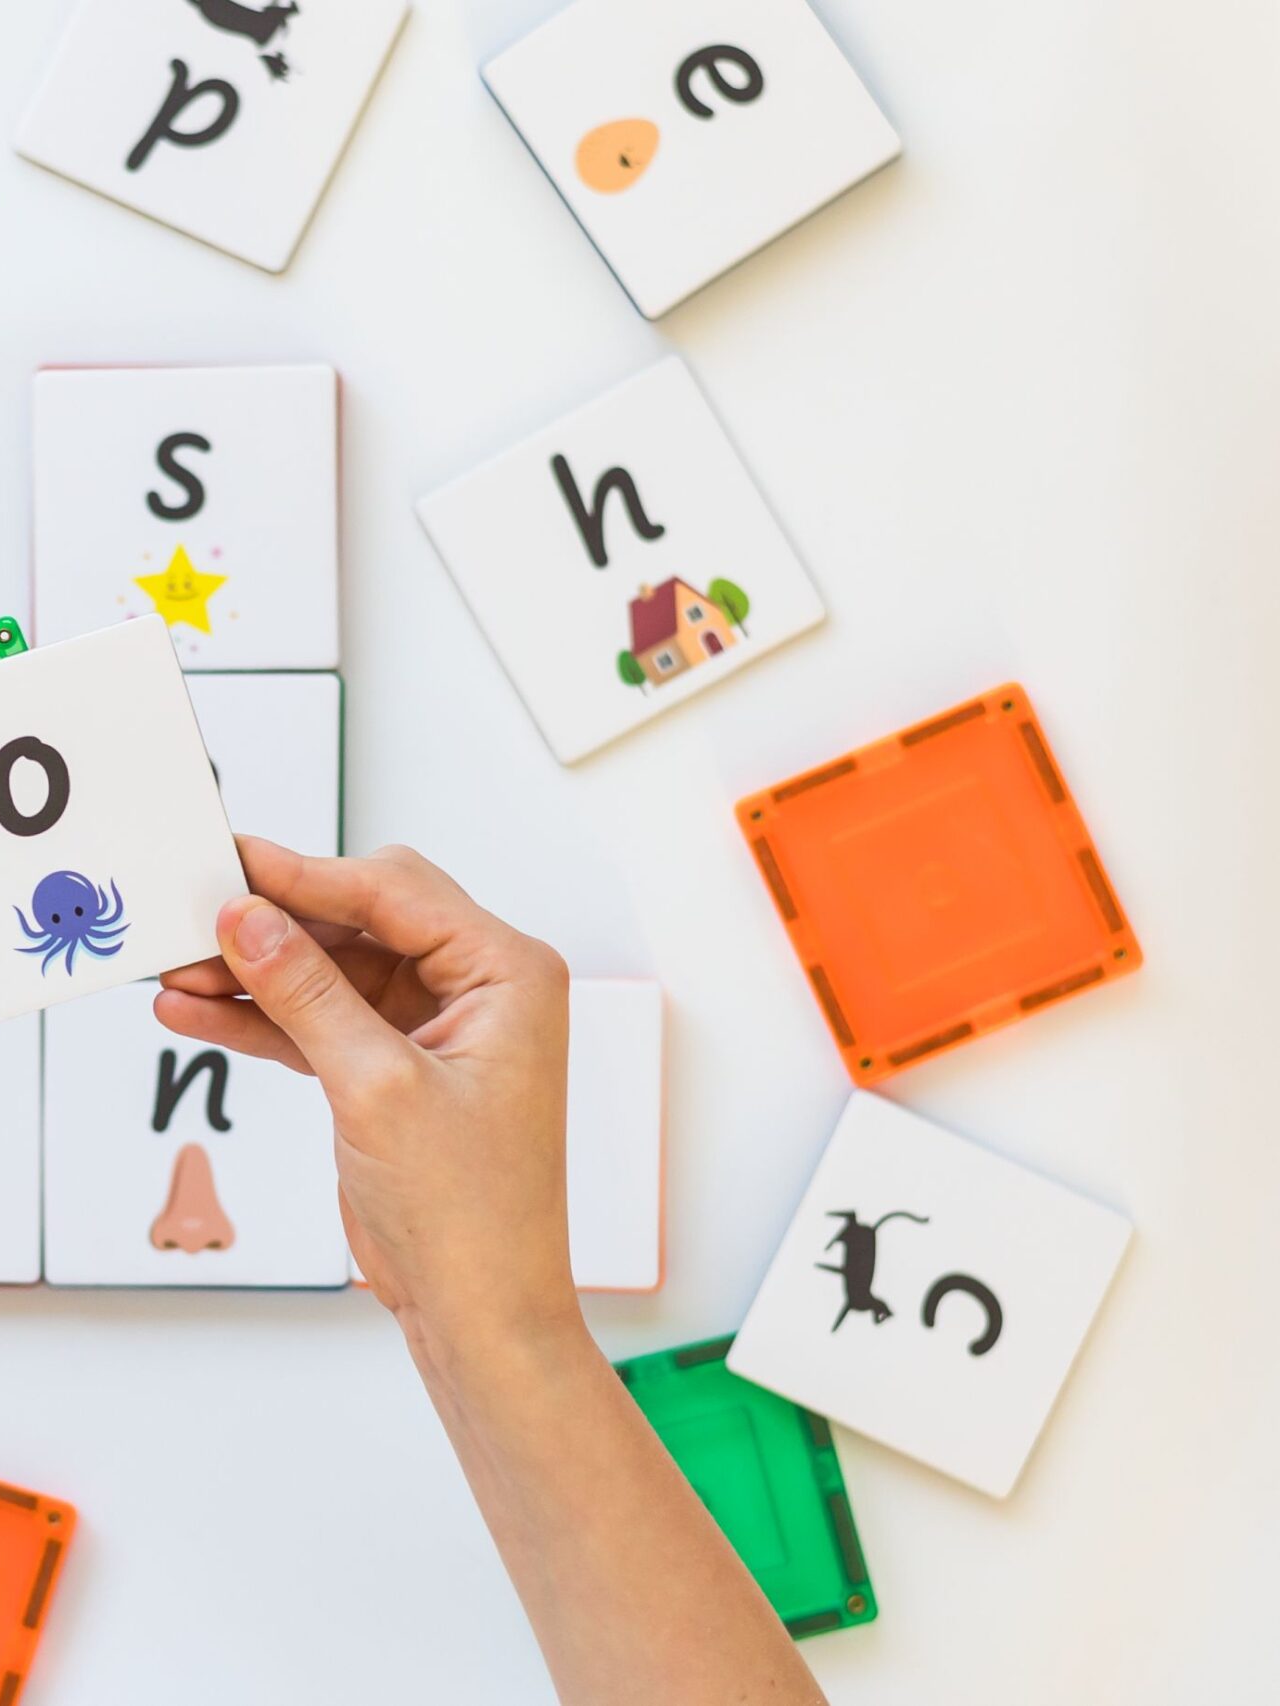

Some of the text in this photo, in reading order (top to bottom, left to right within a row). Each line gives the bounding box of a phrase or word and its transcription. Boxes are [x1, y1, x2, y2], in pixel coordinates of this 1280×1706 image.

[675, 44, 765, 119] e
[147, 431, 212, 521] s
[551, 453, 665, 568] h
[151, 1047, 232, 1133] n
[922, 1272, 1004, 1357] c
